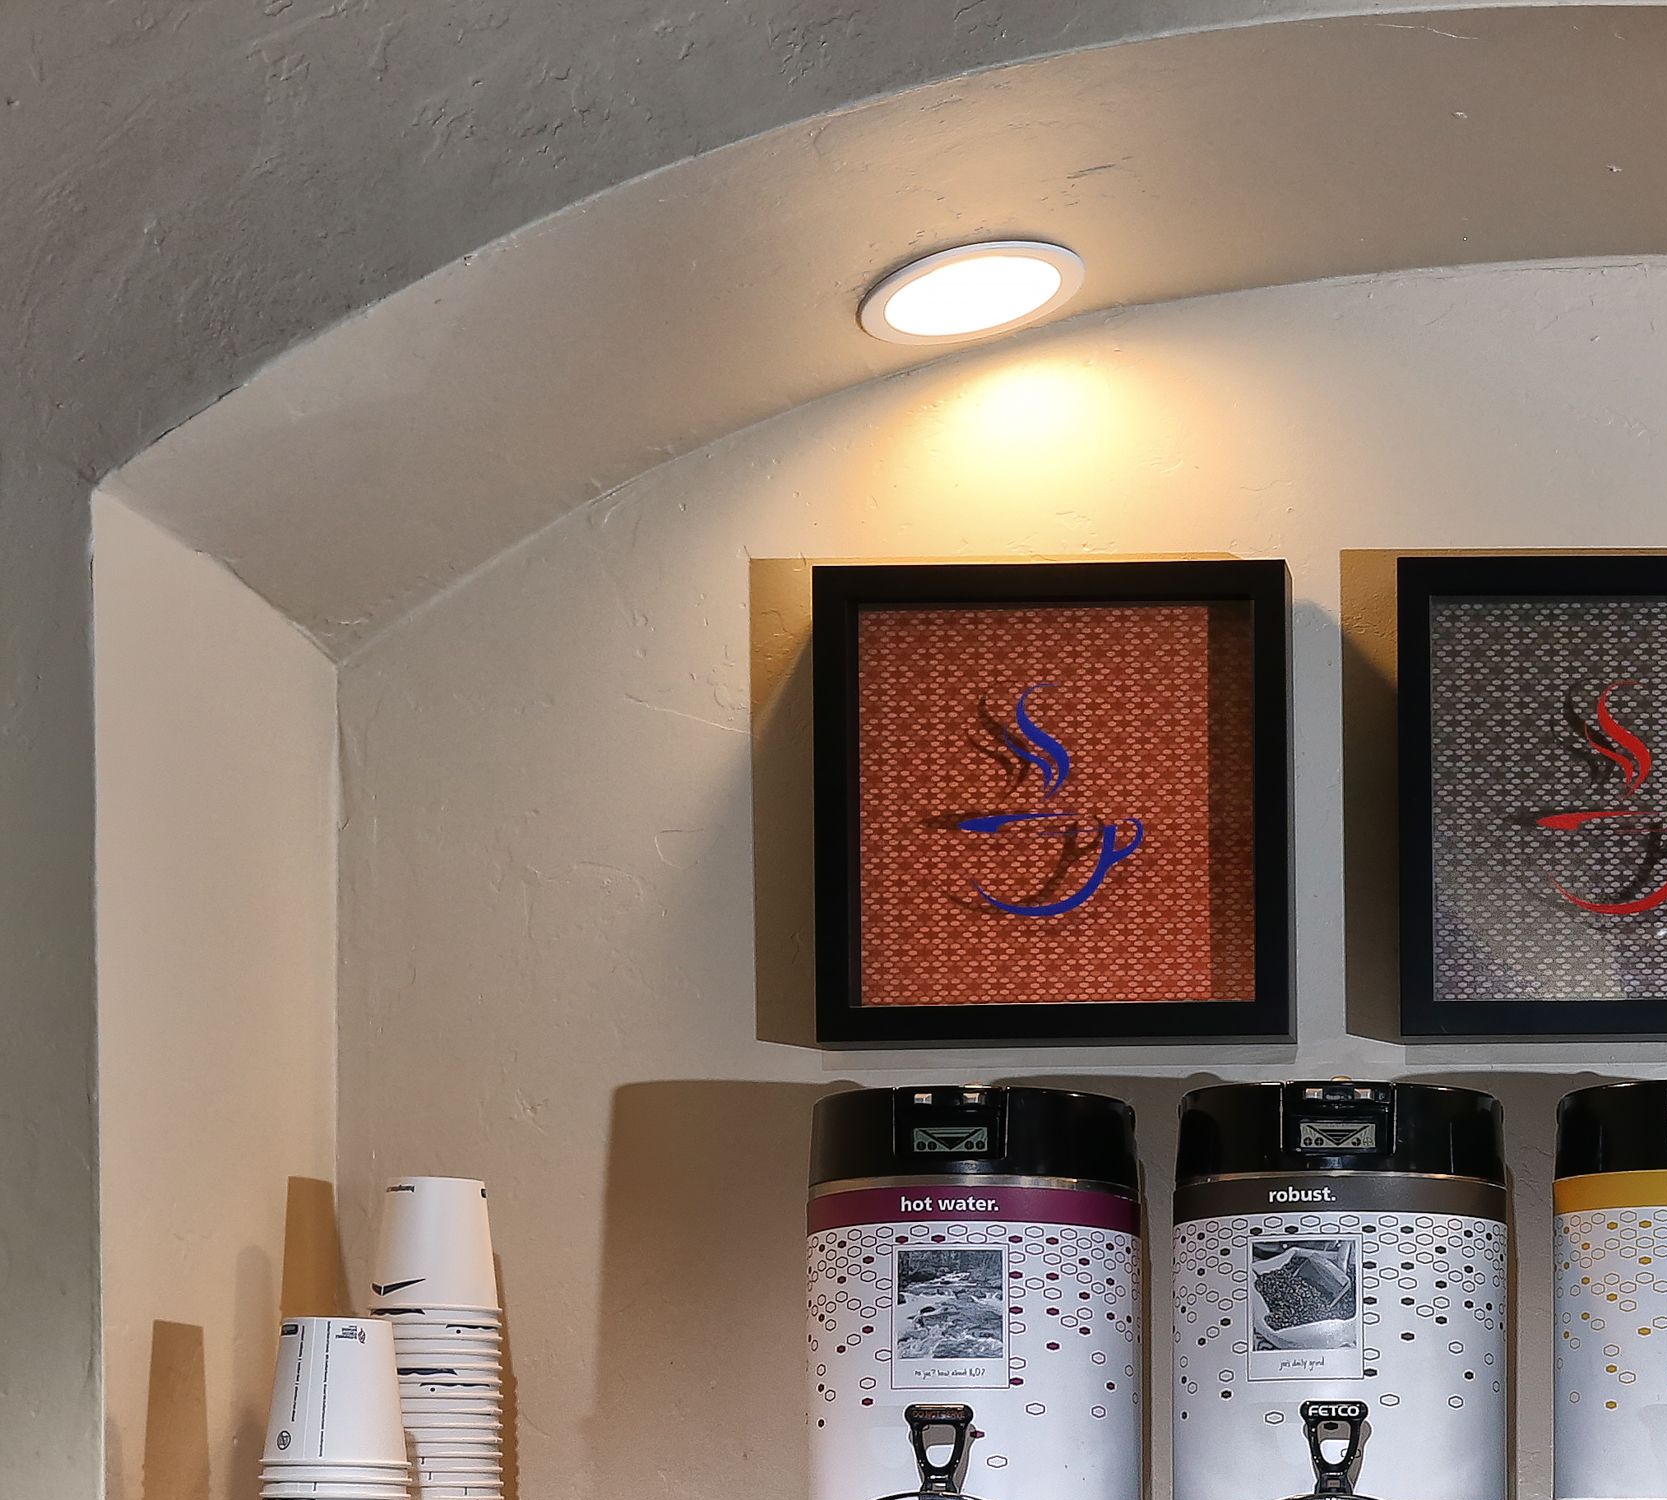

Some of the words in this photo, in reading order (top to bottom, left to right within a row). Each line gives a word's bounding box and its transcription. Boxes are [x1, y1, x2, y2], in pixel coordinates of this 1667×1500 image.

[1268, 1185, 1338, 1203] robust.
[900, 1195, 933, 1212] hot
[937, 1196, 1000, 1212] water.
[1307, 1405, 1360, 1417] FETCO
